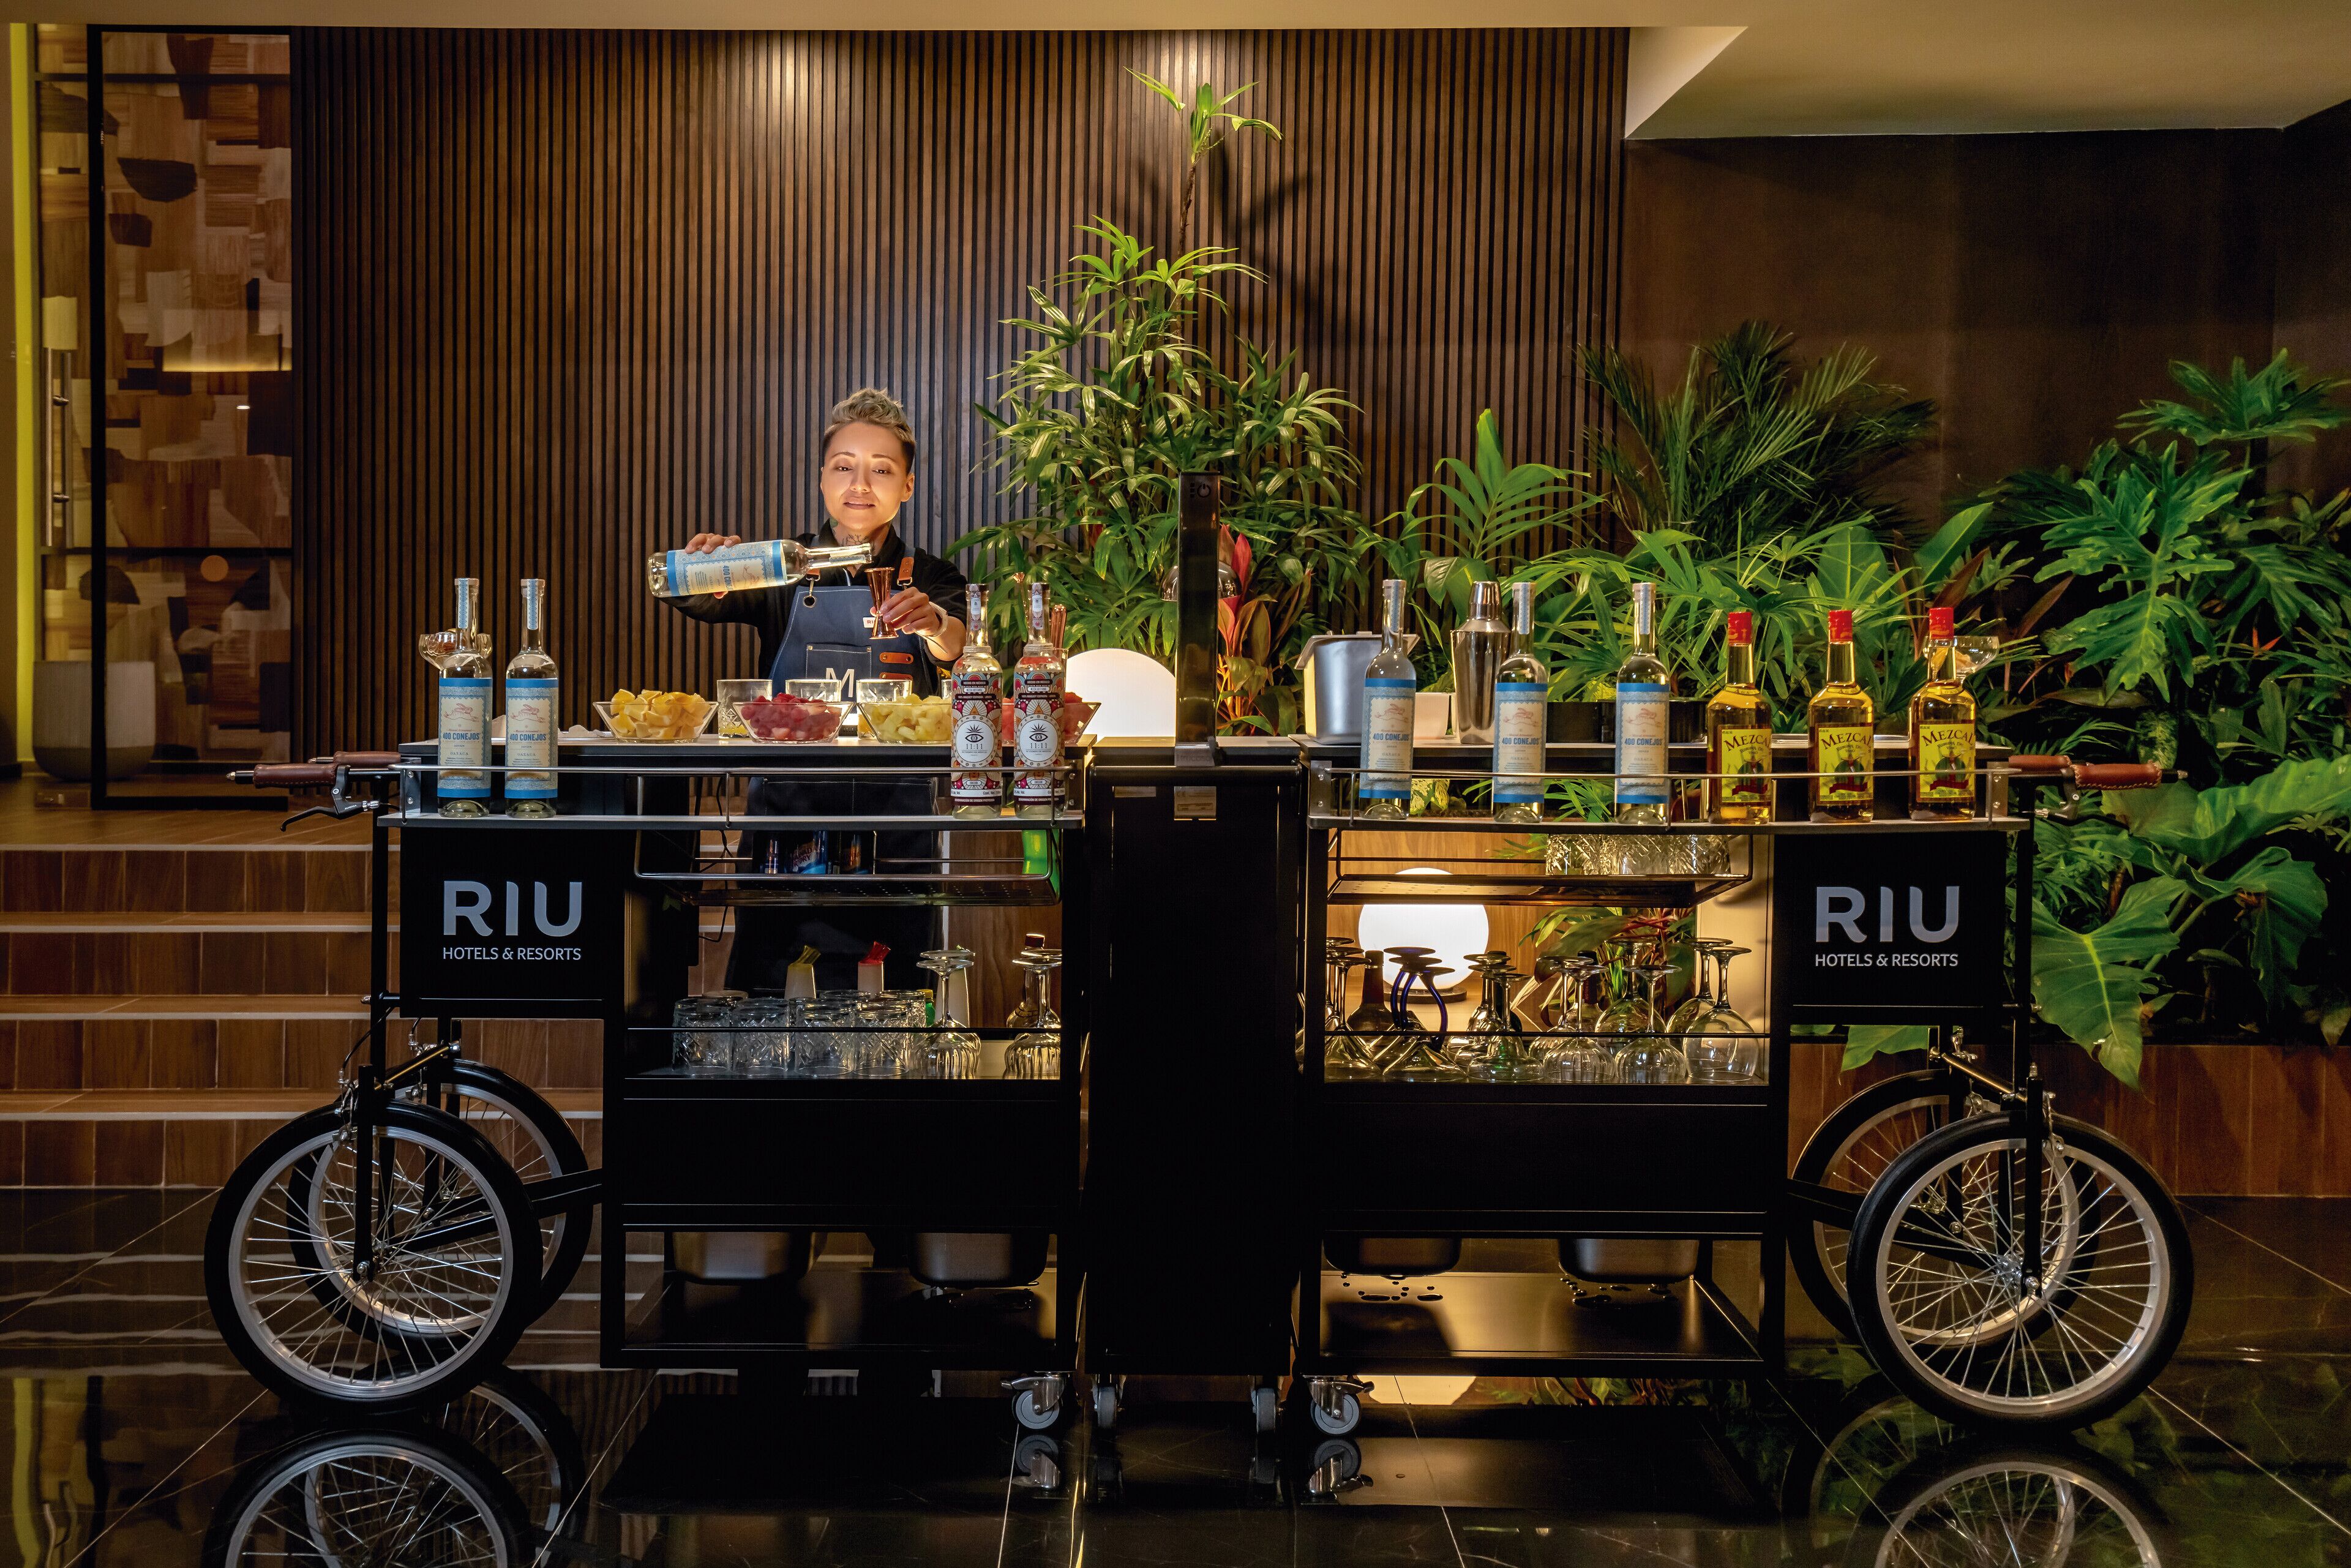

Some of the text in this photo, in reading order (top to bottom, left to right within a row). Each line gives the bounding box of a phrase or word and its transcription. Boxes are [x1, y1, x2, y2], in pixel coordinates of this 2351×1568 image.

[1922, 729, 1973, 746] MEZCAL
[443, 880, 582, 937] RIU
[1816, 886, 1959, 943] RIU
[443, 947, 581, 960] HOTELS & RESORTS
[1815, 954, 1958, 967] HOTELS & RESORTS
